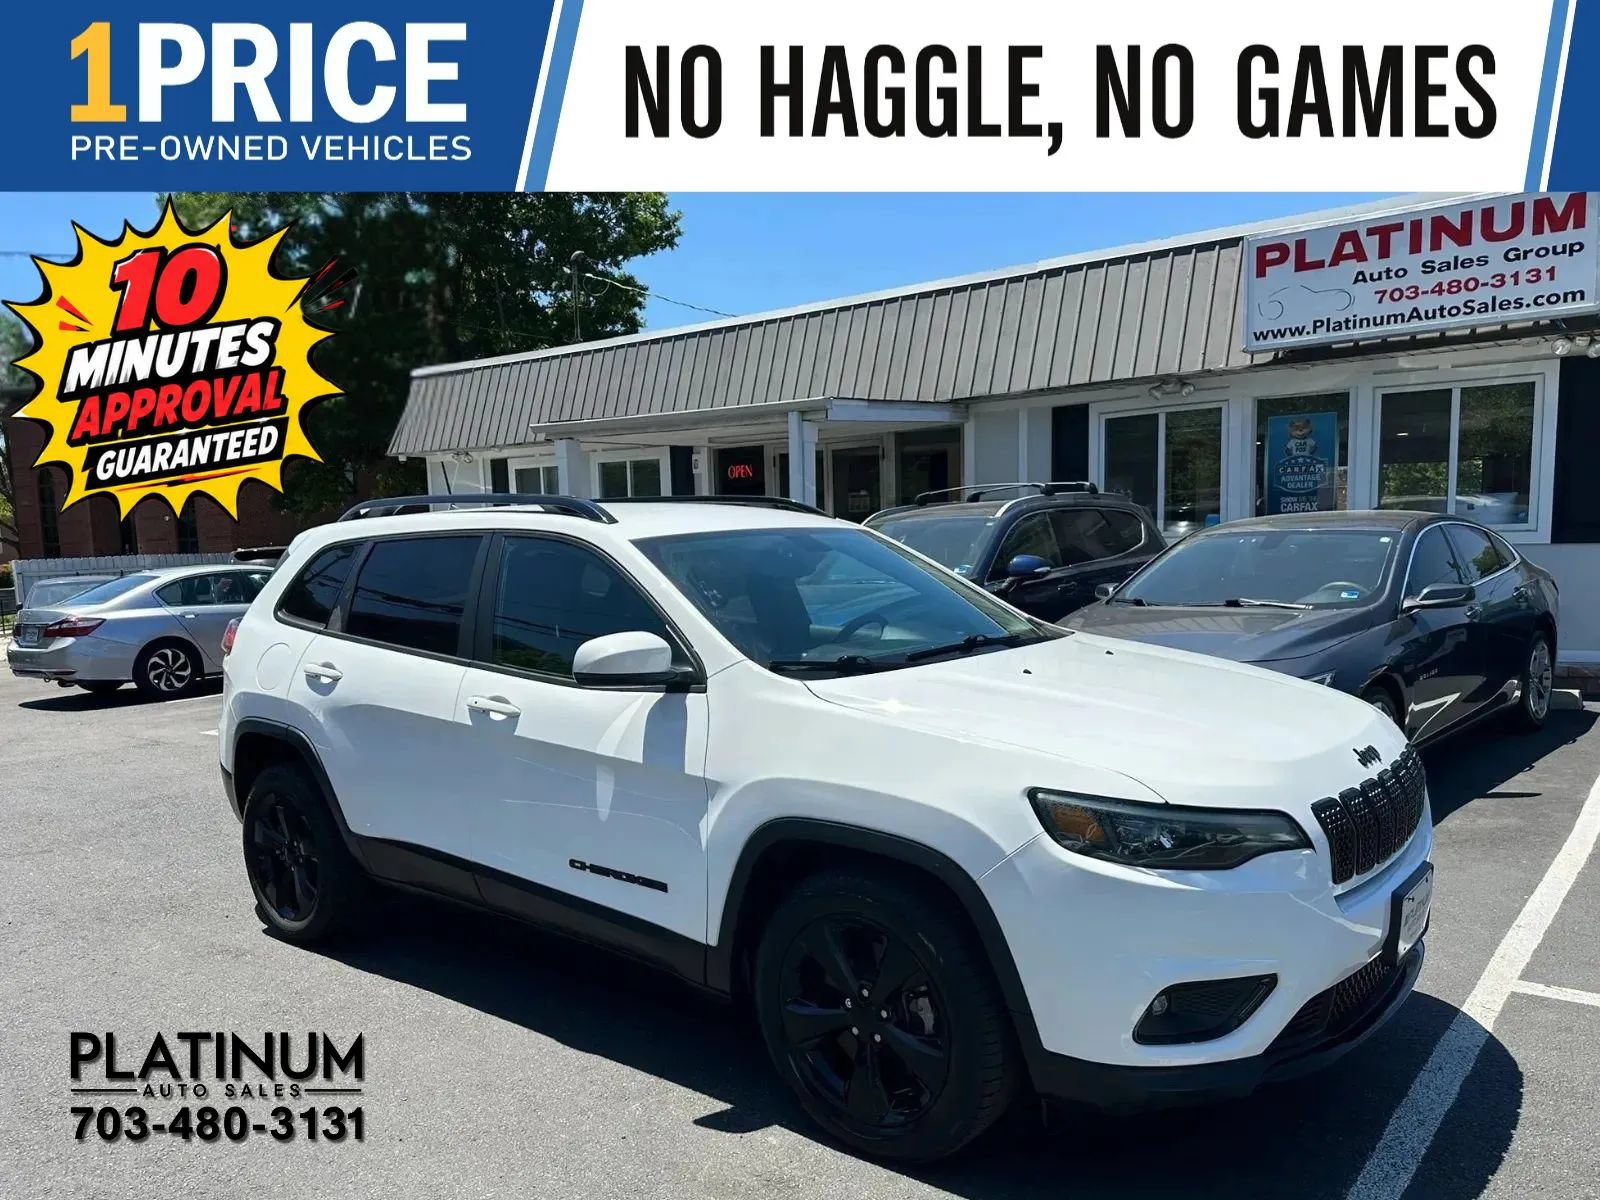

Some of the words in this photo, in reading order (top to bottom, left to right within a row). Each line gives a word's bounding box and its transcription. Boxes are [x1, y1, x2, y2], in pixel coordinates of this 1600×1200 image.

[1256, 192, 1588, 278] PLATINUM
[1352, 266, 1408, 284] Auto
[1421, 253, 1489, 275] Sales
[1503, 241, 1585, 263] Group
[1374, 266, 1556, 304] 703-480-3131
[1253, 288, 1586, 342] www.PlatinumAutoSales.com
[727, 464, 753, 479] OPEN
[1280, 502, 1318, 512] CARFAX
